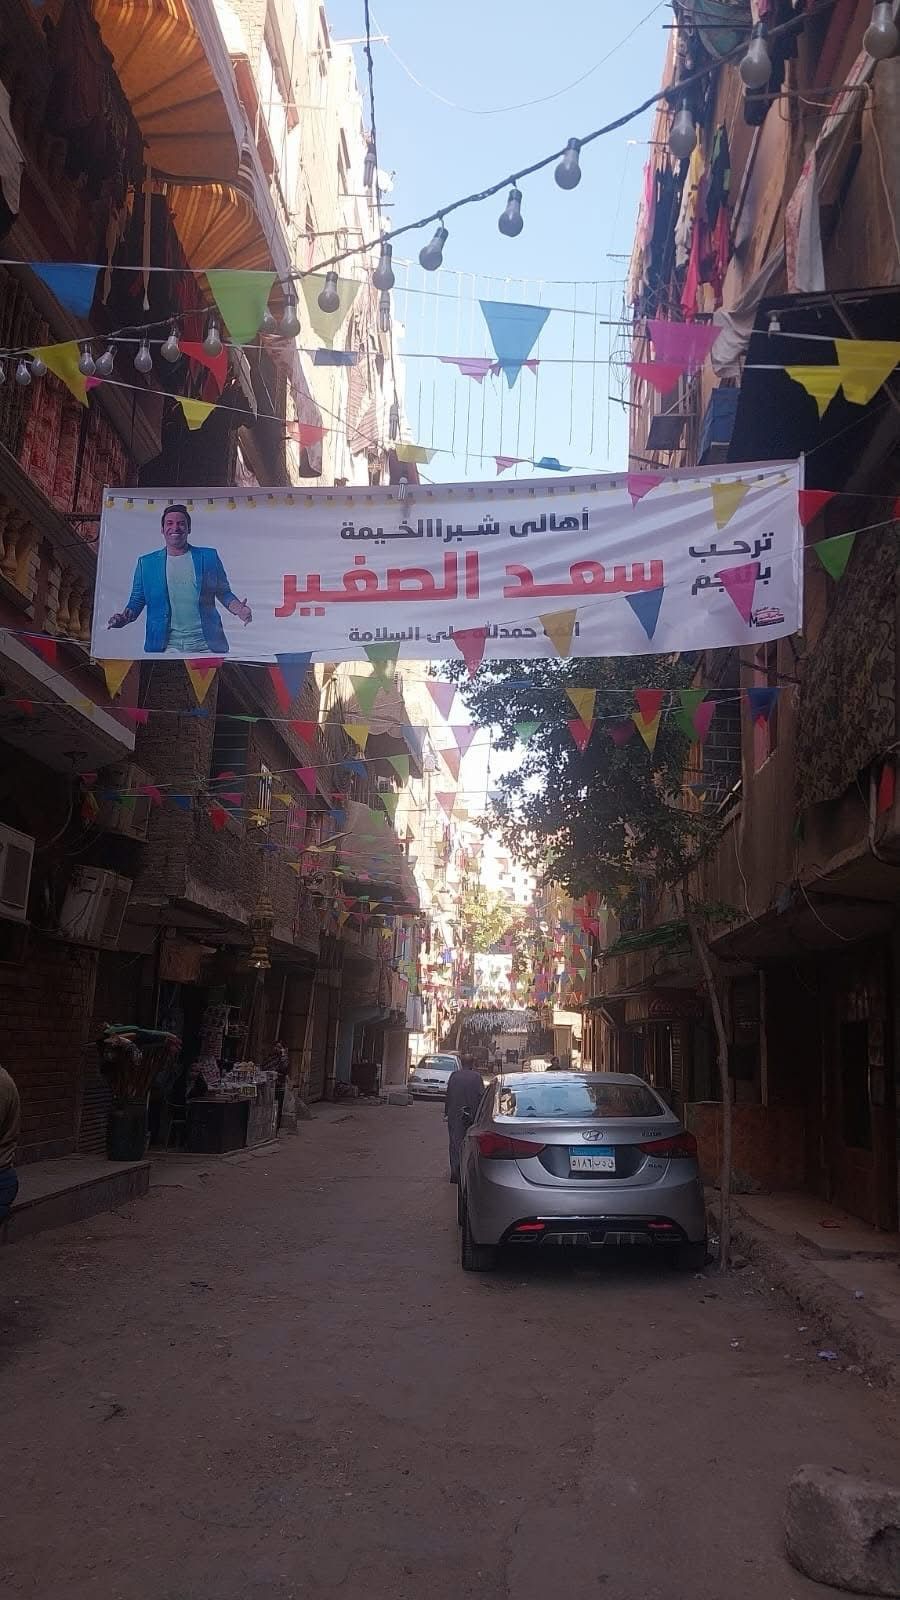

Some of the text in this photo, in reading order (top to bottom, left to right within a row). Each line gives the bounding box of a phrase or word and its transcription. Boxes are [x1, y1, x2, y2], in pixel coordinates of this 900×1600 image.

[688, 532, 774, 563] ترحب
[274, 550, 664, 618] سعد الصغير
[348, 626, 420, 643] السلامة
[427, 625, 466, 644] لى
